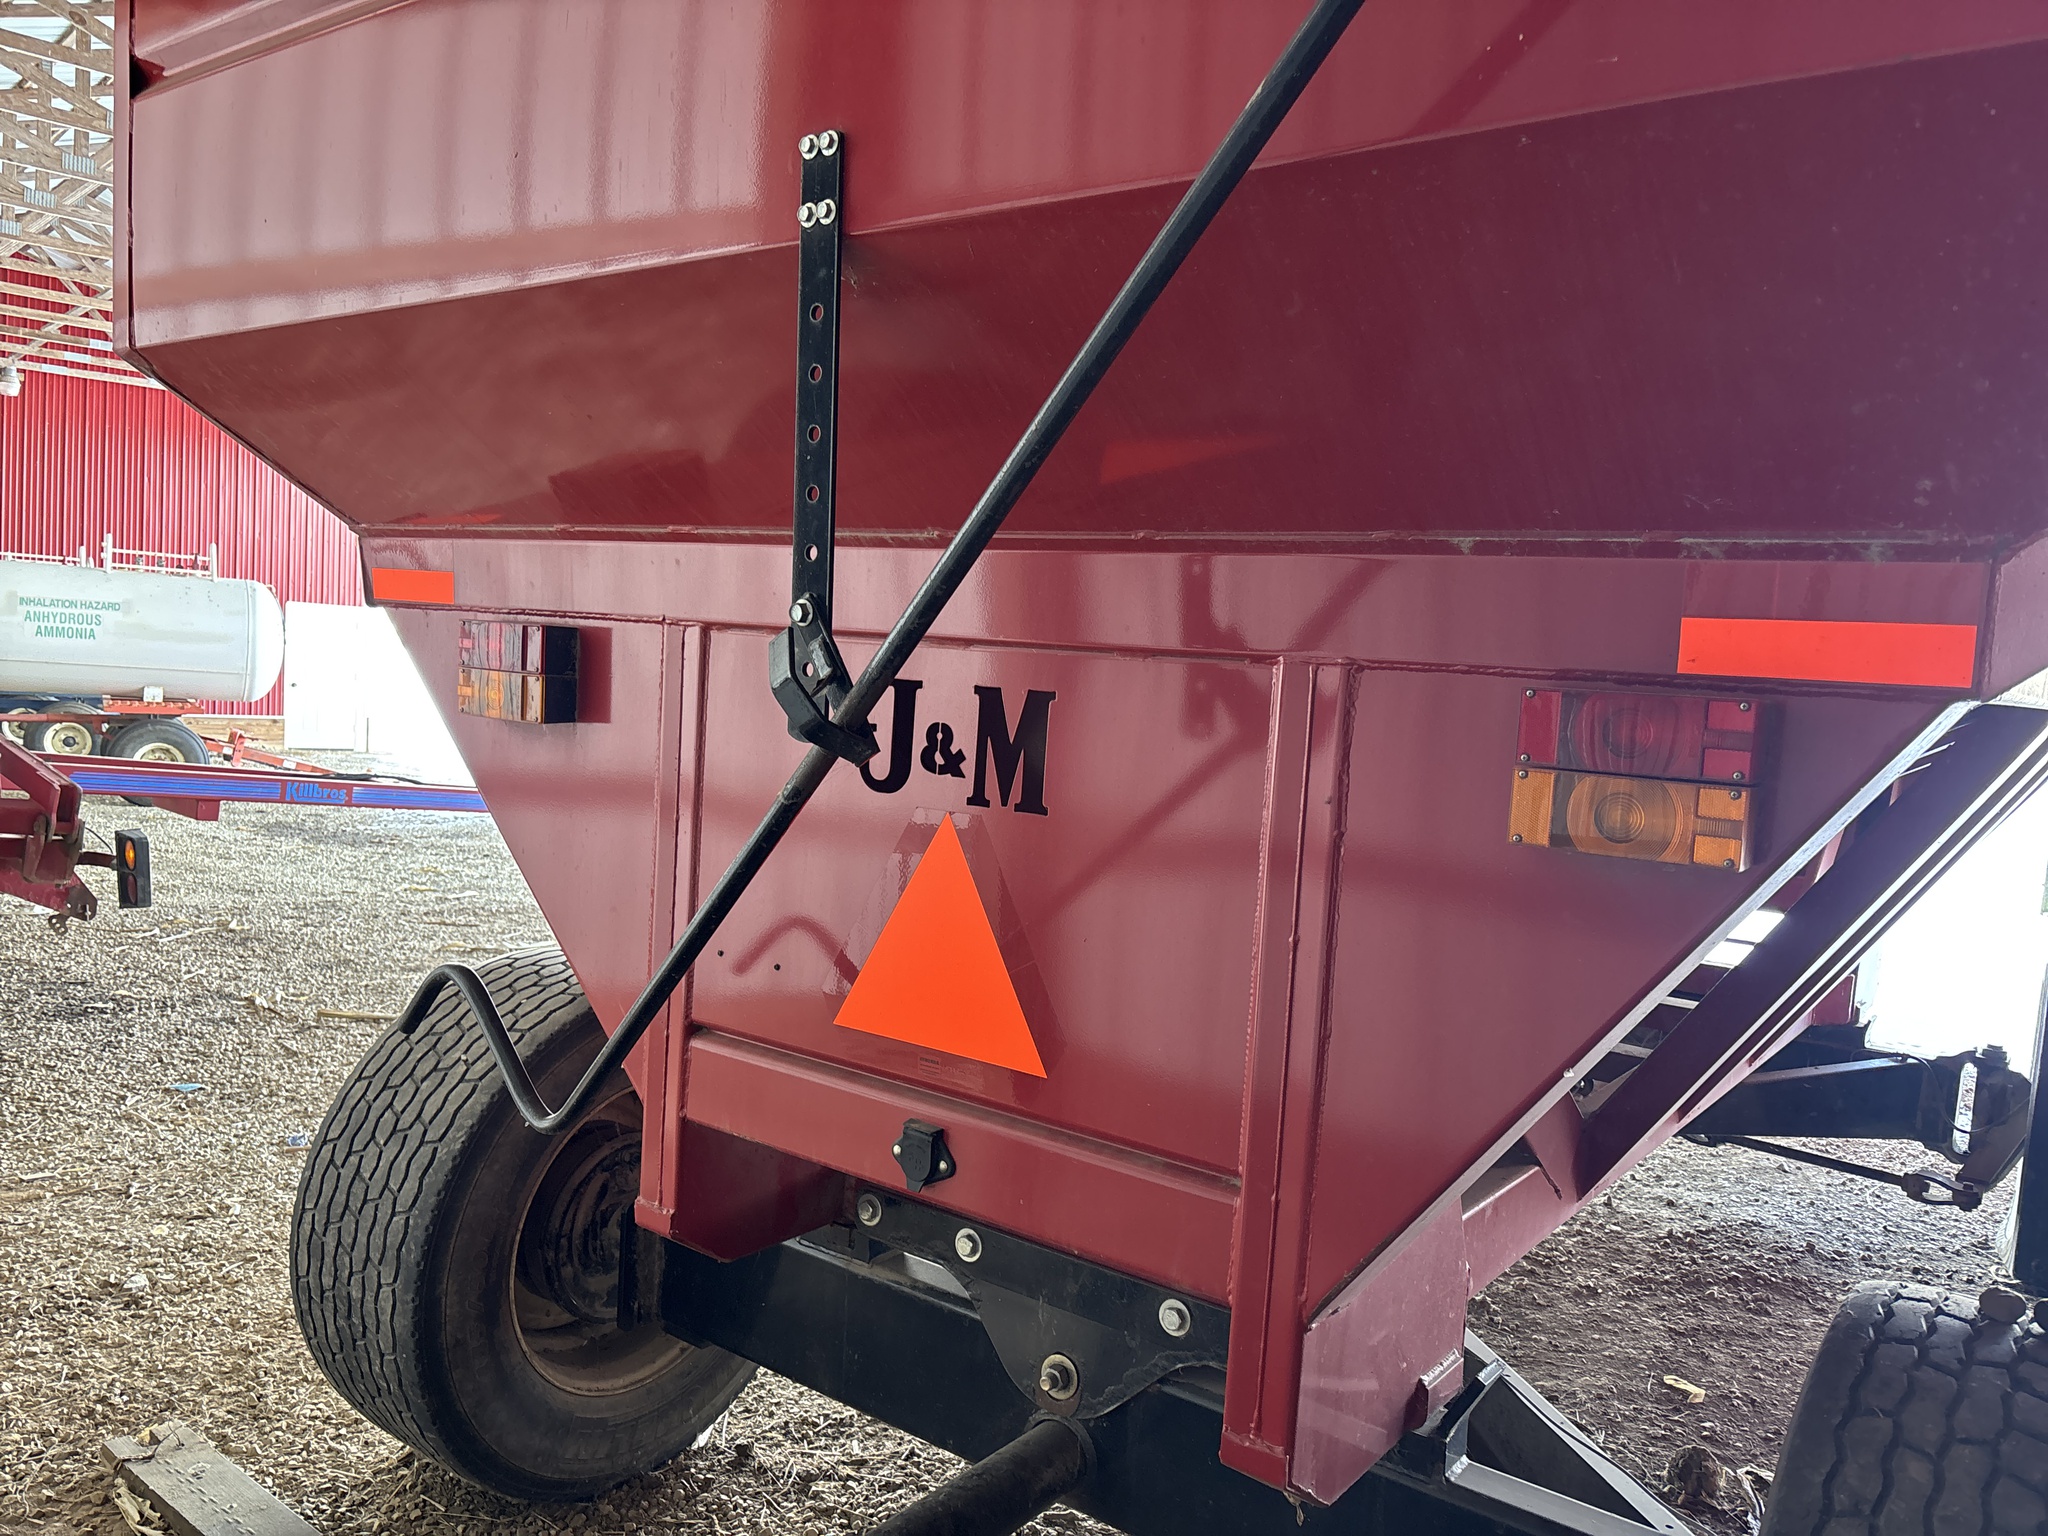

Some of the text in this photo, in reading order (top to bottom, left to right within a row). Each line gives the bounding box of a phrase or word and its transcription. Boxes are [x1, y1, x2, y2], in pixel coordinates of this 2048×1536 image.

[20, 597, 121, 612] INHALATION HAZARD
[24, 610, 102, 626] ANHYDROUS
[35, 625, 96, 640] AMMONIA
[860, 679, 1057, 816] J&M
[285, 781, 347, 803] Killbros
